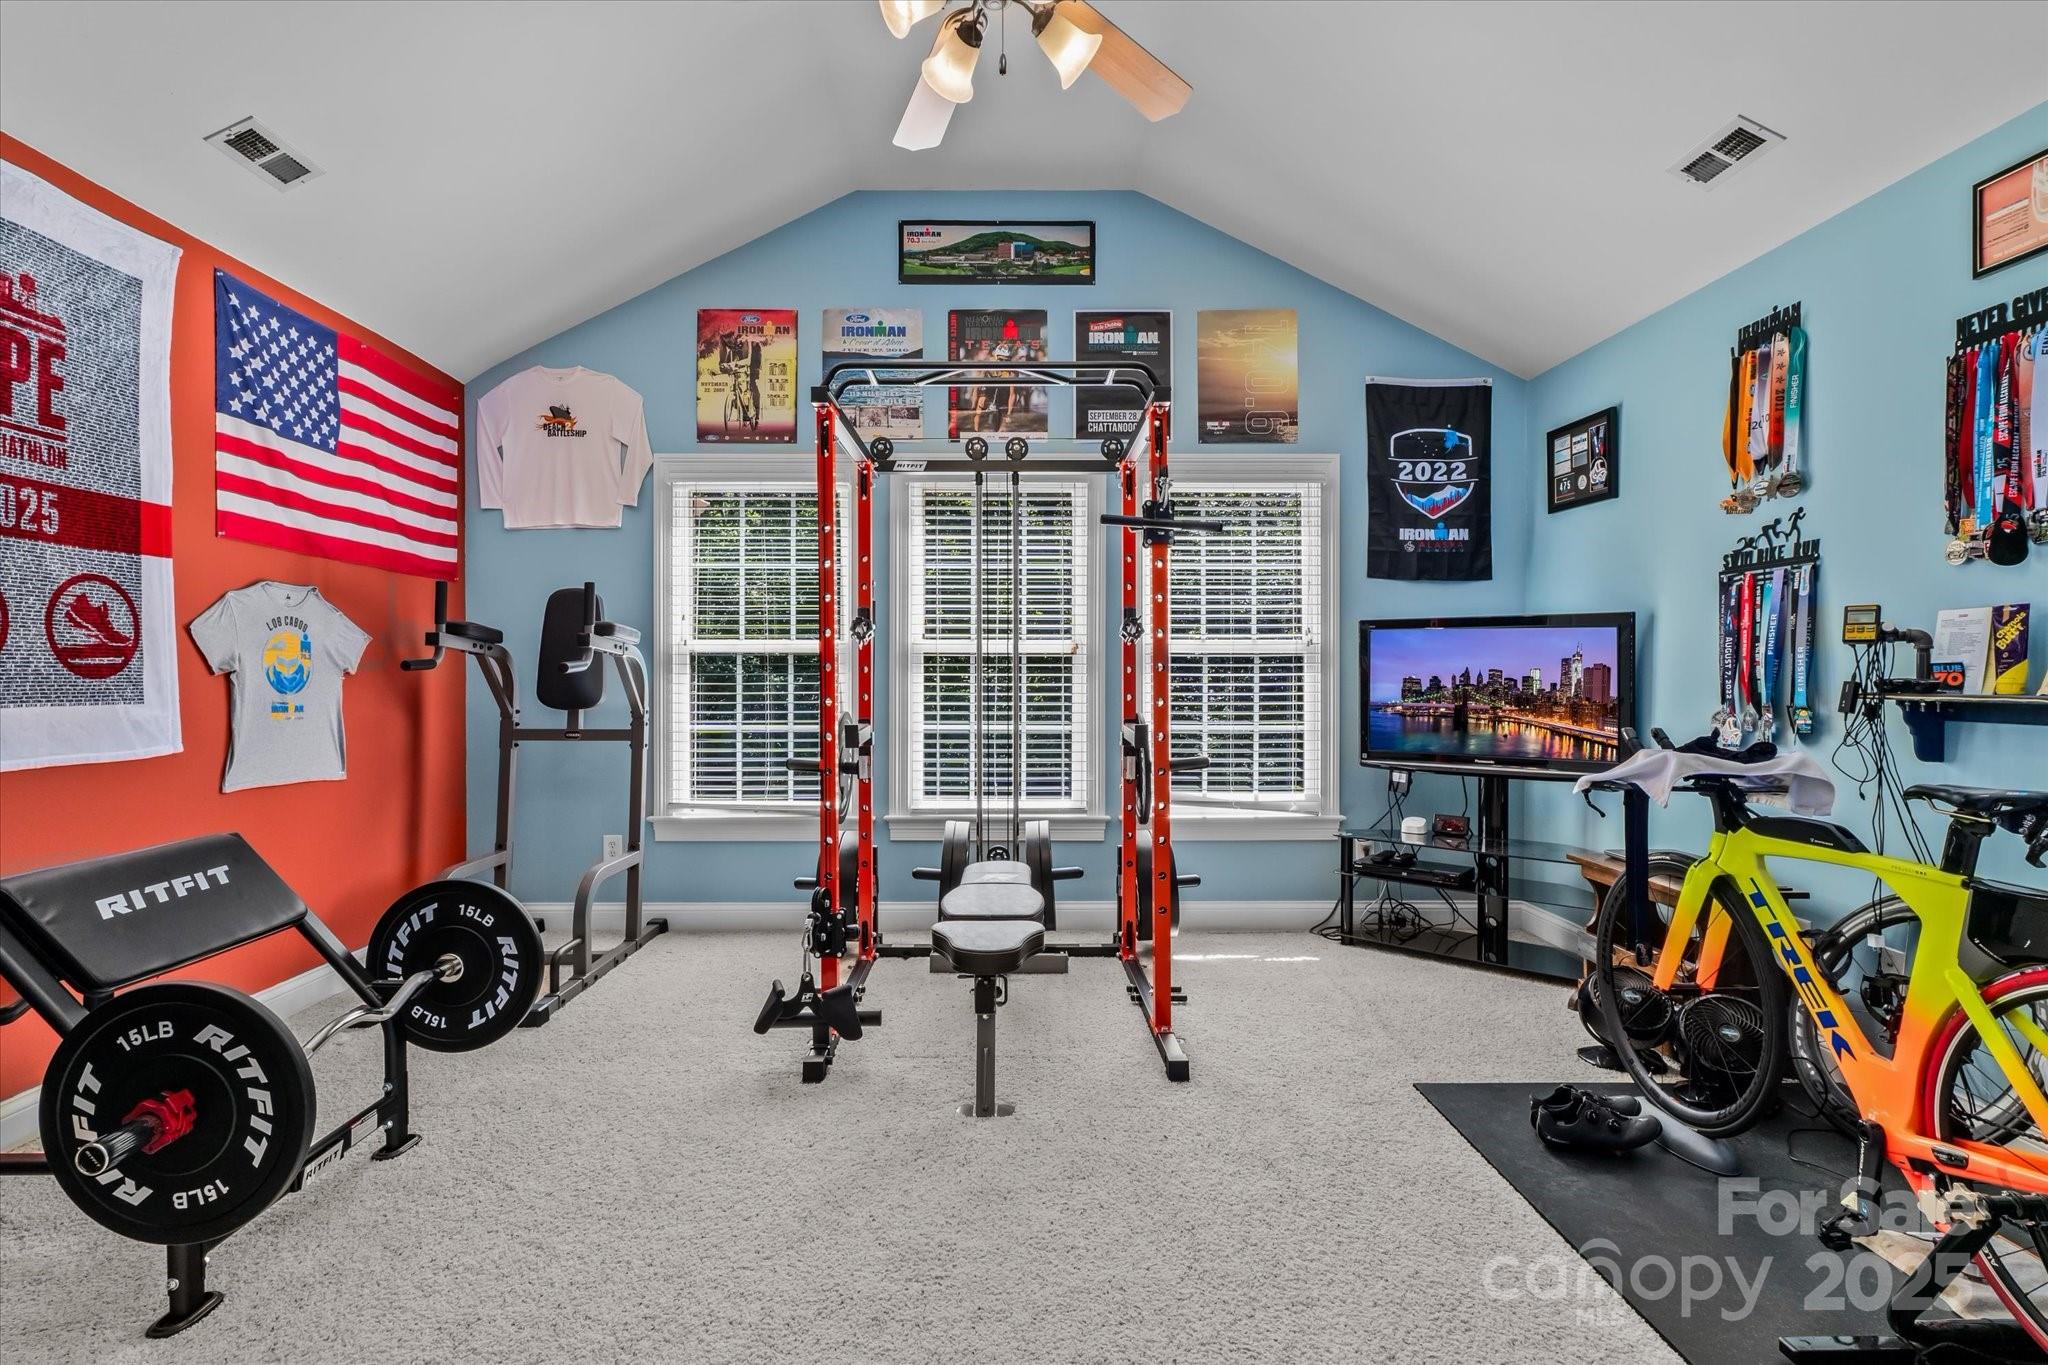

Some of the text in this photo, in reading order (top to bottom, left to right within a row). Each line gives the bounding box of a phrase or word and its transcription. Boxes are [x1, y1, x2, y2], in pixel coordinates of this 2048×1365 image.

[907, 228, 942, 237] IRONMAN
[738, 323, 790, 335] IRONMAN
[842, 324, 906, 337] IRONMAN
[1738, 301, 1801, 341] IRONMAN
[1956, 302, 2008, 339] NEVER
[1089, 329, 1160, 344] IRONMAN
[1775, 388, 1785, 412] 2011
[1790, 374, 1799, 409] FINISHER
[543, 423, 566, 431] BEACH
[1089, 411, 1127, 420] SEPTEMBER
[896, 462, 925, 470] RITFIT
[1398, 462, 1467, 481] 2022
[2009, 478, 2018, 498] ESCAPE
[1399, 525, 1469, 541] IRONMAN
[1723, 538, 1820, 568] SWIM BIKE RUN
[1768, 614, 1777, 655] FINISHER
[1725, 636, 1733, 668] AUGUST
[1933, 664, 1963, 673] BLUE
[1933, 673, 1963, 686] 70
[1725, 680, 1733, 699] 2022
[95, 864, 232, 920] RITFIT
[458, 903, 495, 928] 15LB
[387, 902, 439, 983] ITFIT
[1749, 877, 1857, 1062] TREK
[468, 935, 520, 1031] RITFIT
[411, 1005, 448, 1030] 15LB
[116, 1020, 174, 1052] 15LB
[193, 1022, 273, 1169] RITFIT
[74, 1061, 154, 1207] RIFIT
[306, 1149, 340, 1180] RITFIT
[172, 1179, 231, 1210] 15LB
